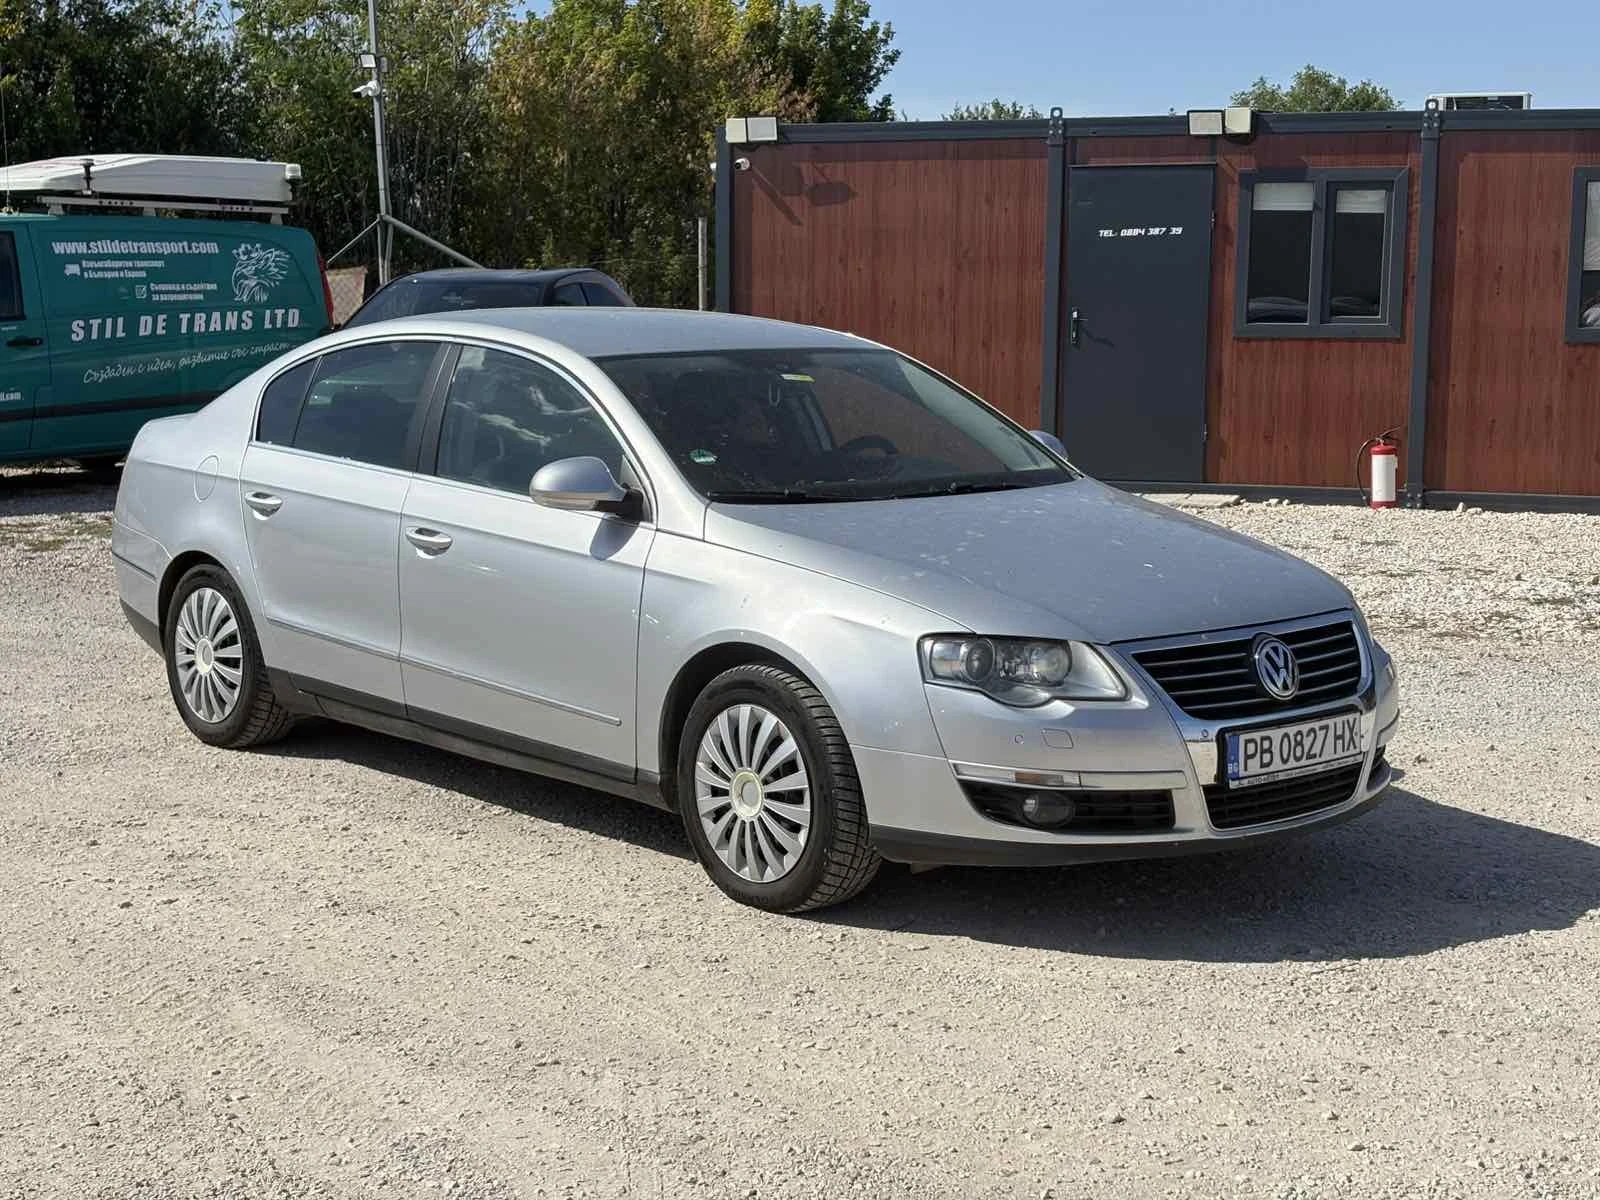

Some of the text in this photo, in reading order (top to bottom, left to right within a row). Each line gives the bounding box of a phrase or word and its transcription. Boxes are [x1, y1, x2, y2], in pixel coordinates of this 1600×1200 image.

[1120, 228, 1146, 237] 0884
[1147, 227, 1168, 235] 387
[52, 240, 219, 255] www.stildetransport.com
[71, 308, 300, 342] STIL DE TRANS LTD
[1243, 735, 1274, 772] PB
[1279, 724, 1330, 765] 0827
[1333, 717, 1358, 755] HX
